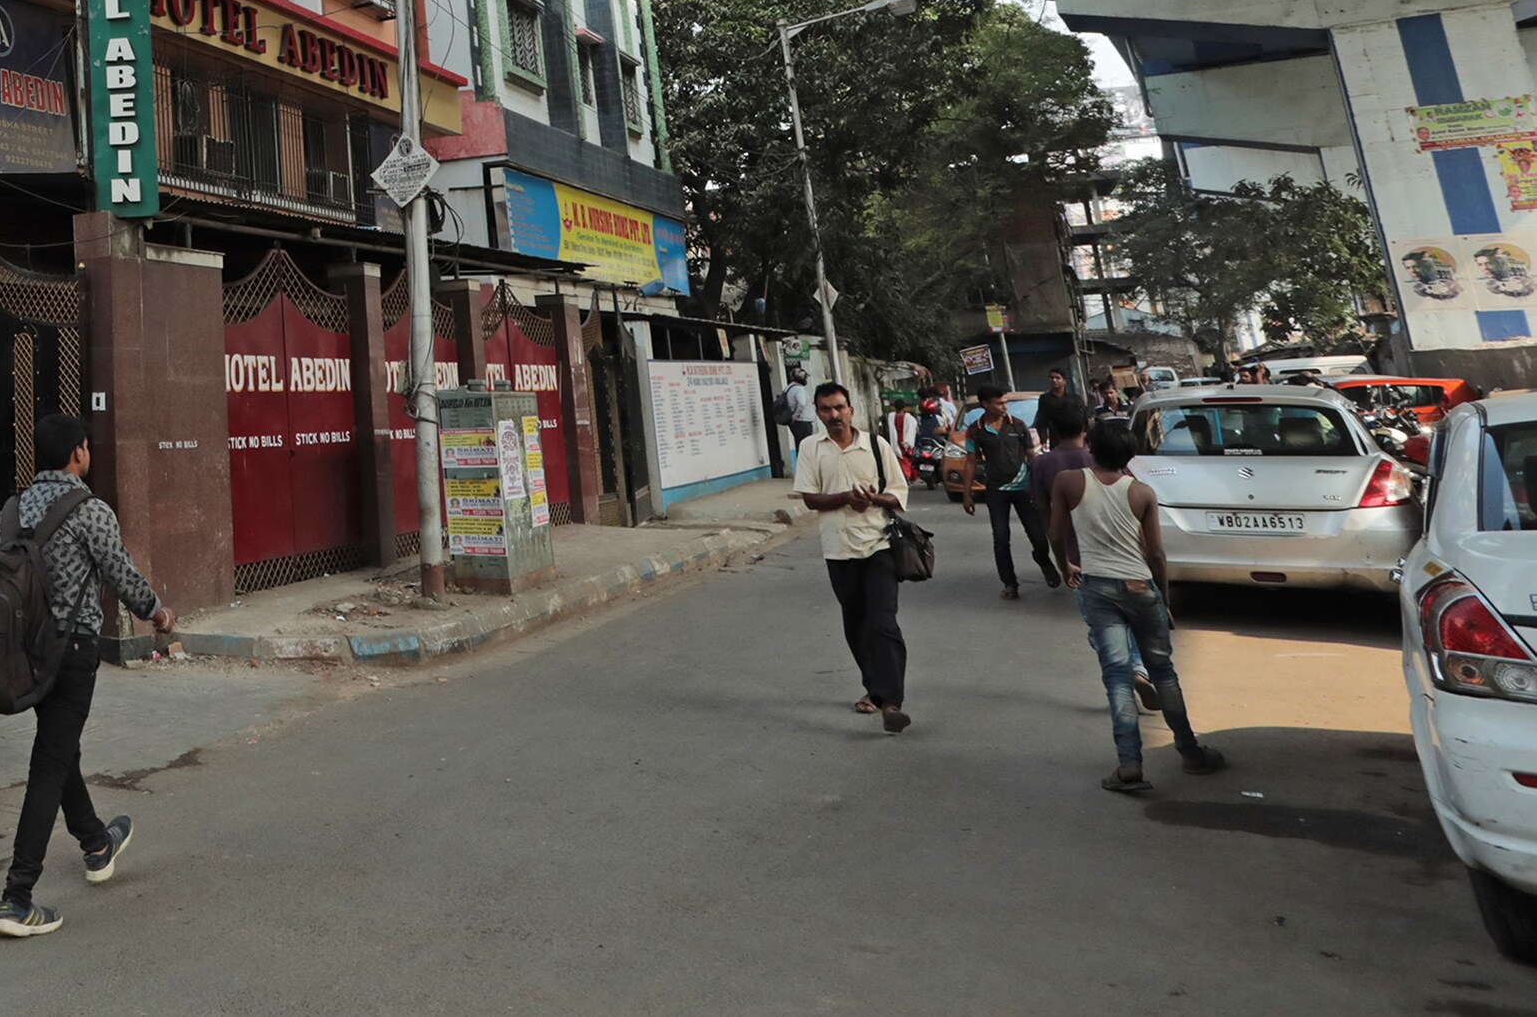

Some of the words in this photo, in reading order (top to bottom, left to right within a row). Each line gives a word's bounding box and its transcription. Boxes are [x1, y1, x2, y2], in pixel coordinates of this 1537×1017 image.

[277, 23, 390, 100] ABEDIN
[0, 68, 67, 117] ABEDIN
[104, 37, 142, 204] ABEDIN
[290, 357, 352, 393] ABEDIN
[434, 361, 459, 391] EDIN
[486, 363, 506, 391] TEL
[514, 364, 558, 392] ABEDIN
[295, 433, 318, 446] STICK
[320, 432, 330, 444] NO
[331, 431, 351, 443] BILLS
[542, 419, 558, 429] BILLS
[159, 441, 174, 450] STICK
[176, 441, 183, 449] NO
[184, 440, 198, 449] BILLS
[249, 436, 260, 449] NO
[262, 435, 283, 448] BILLS
[1217, 516, 1304, 530] WB02AA6513
